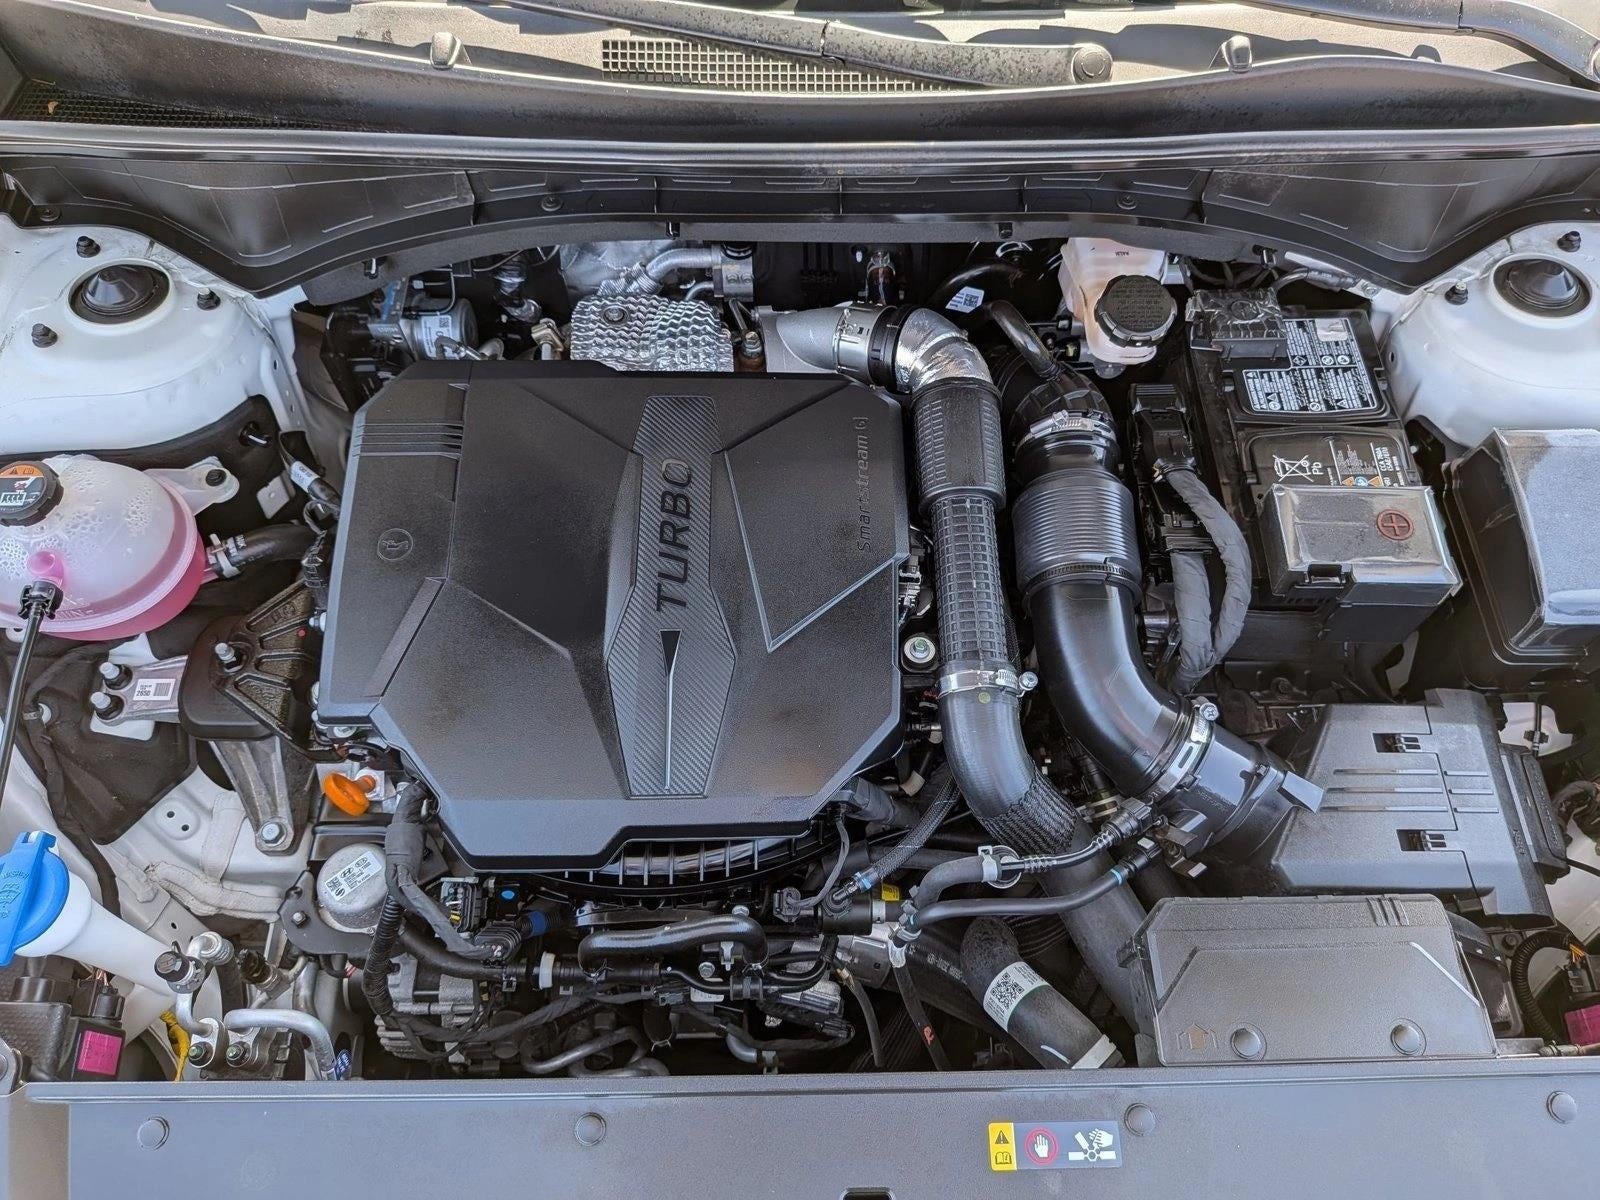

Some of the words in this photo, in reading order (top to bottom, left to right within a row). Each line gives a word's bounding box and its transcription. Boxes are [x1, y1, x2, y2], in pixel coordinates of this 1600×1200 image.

[856, 434, 871, 552] Smartstream
[1312, 461, 1324, 475] Pb
[656, 457, 692, 613] TURBO
